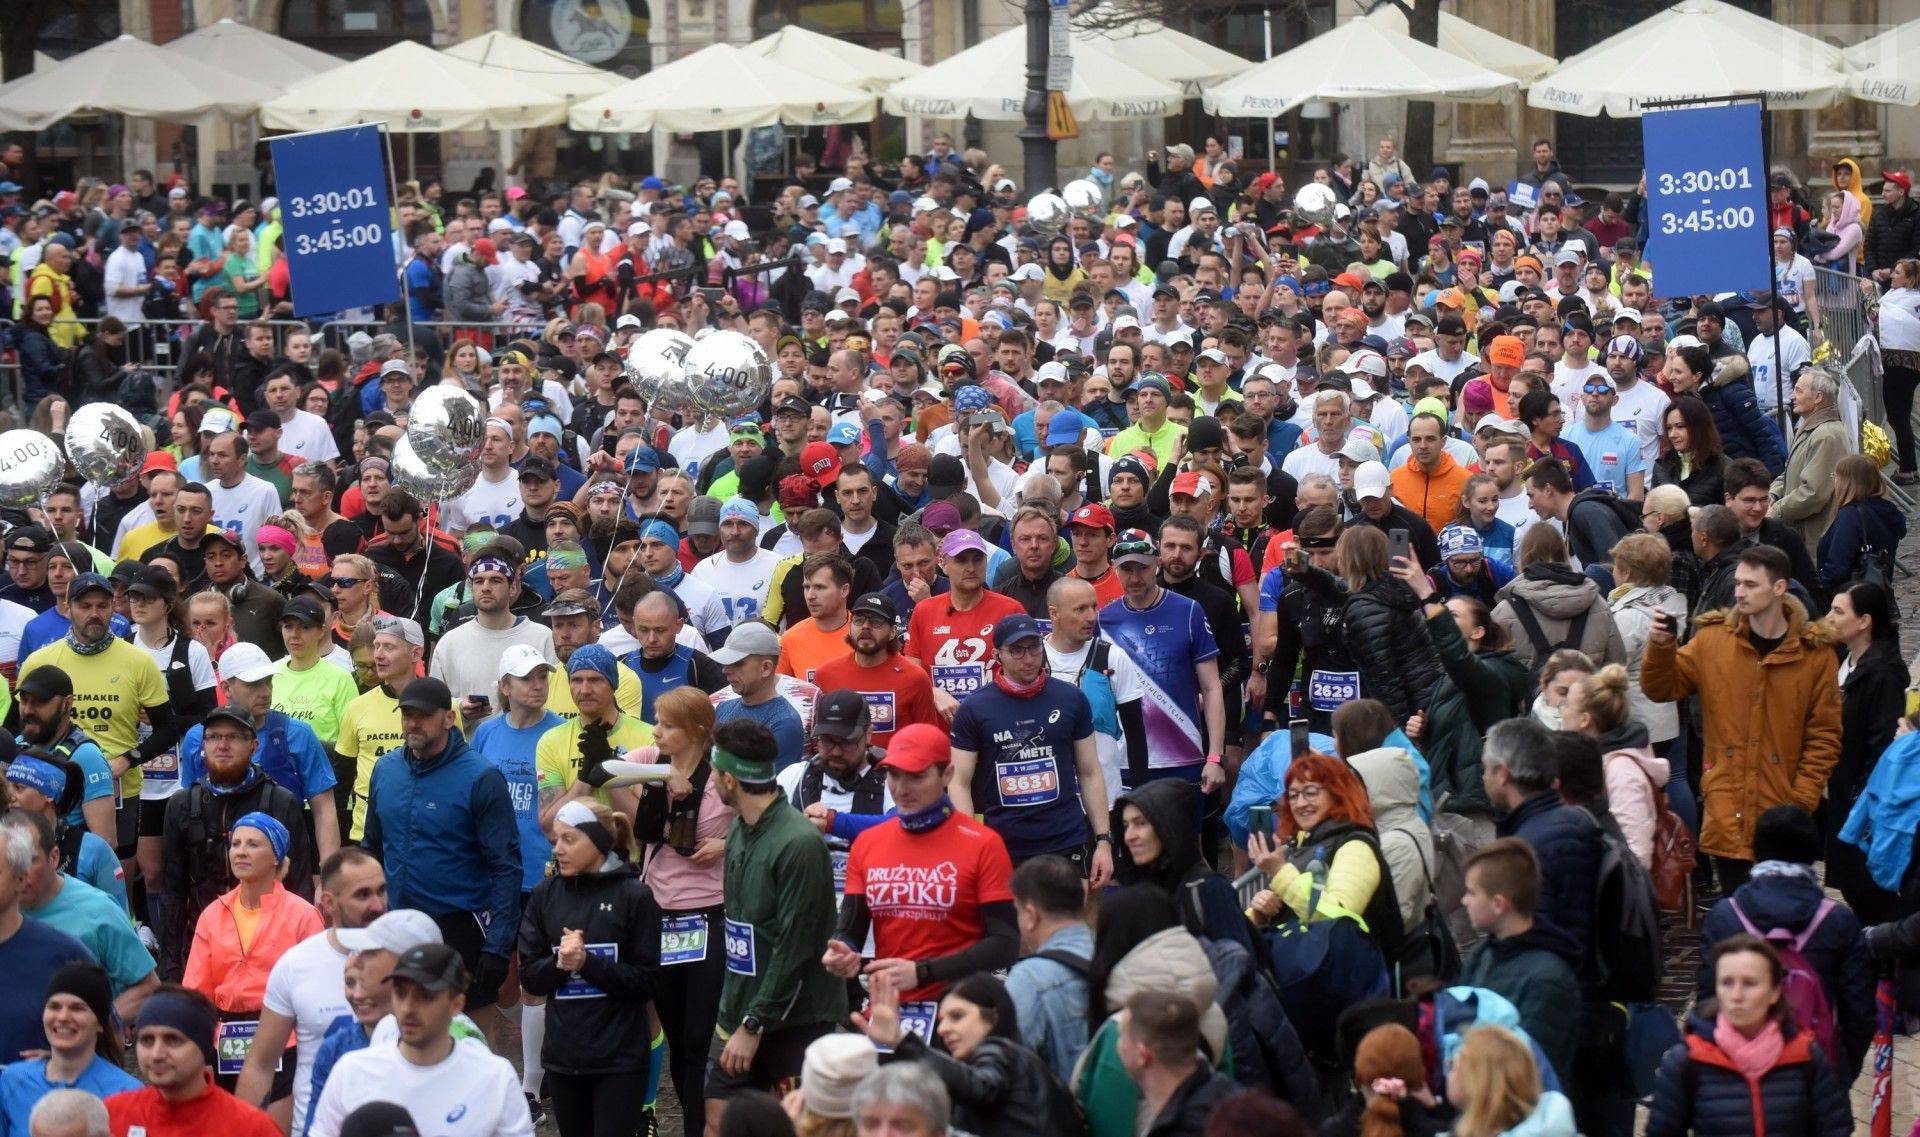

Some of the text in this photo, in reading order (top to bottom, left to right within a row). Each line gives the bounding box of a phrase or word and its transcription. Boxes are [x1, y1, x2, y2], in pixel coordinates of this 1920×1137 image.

[1658, 167, 1752, 195] 3:30:01
[291, 186, 377, 217] 3:30:01
[1661, 206, 1755, 234] 3:45:00
[296, 224, 382, 255] 3:45:00
[704, 362, 748, 388] 4:00
[100, 427, 138, 453] 4:00
[0, 442, 40, 472] 4:00
[936, 678, 979, 692] 2549
[1314, 683, 1354, 698] 2629
[70, 706, 113, 720] 4:00
[993, 730, 1014, 743] NA
[1006, 773, 1052, 792] 3631
[866, 863, 939, 883] DRUŻYNA
[866, 881, 957, 908] SZPIKU
